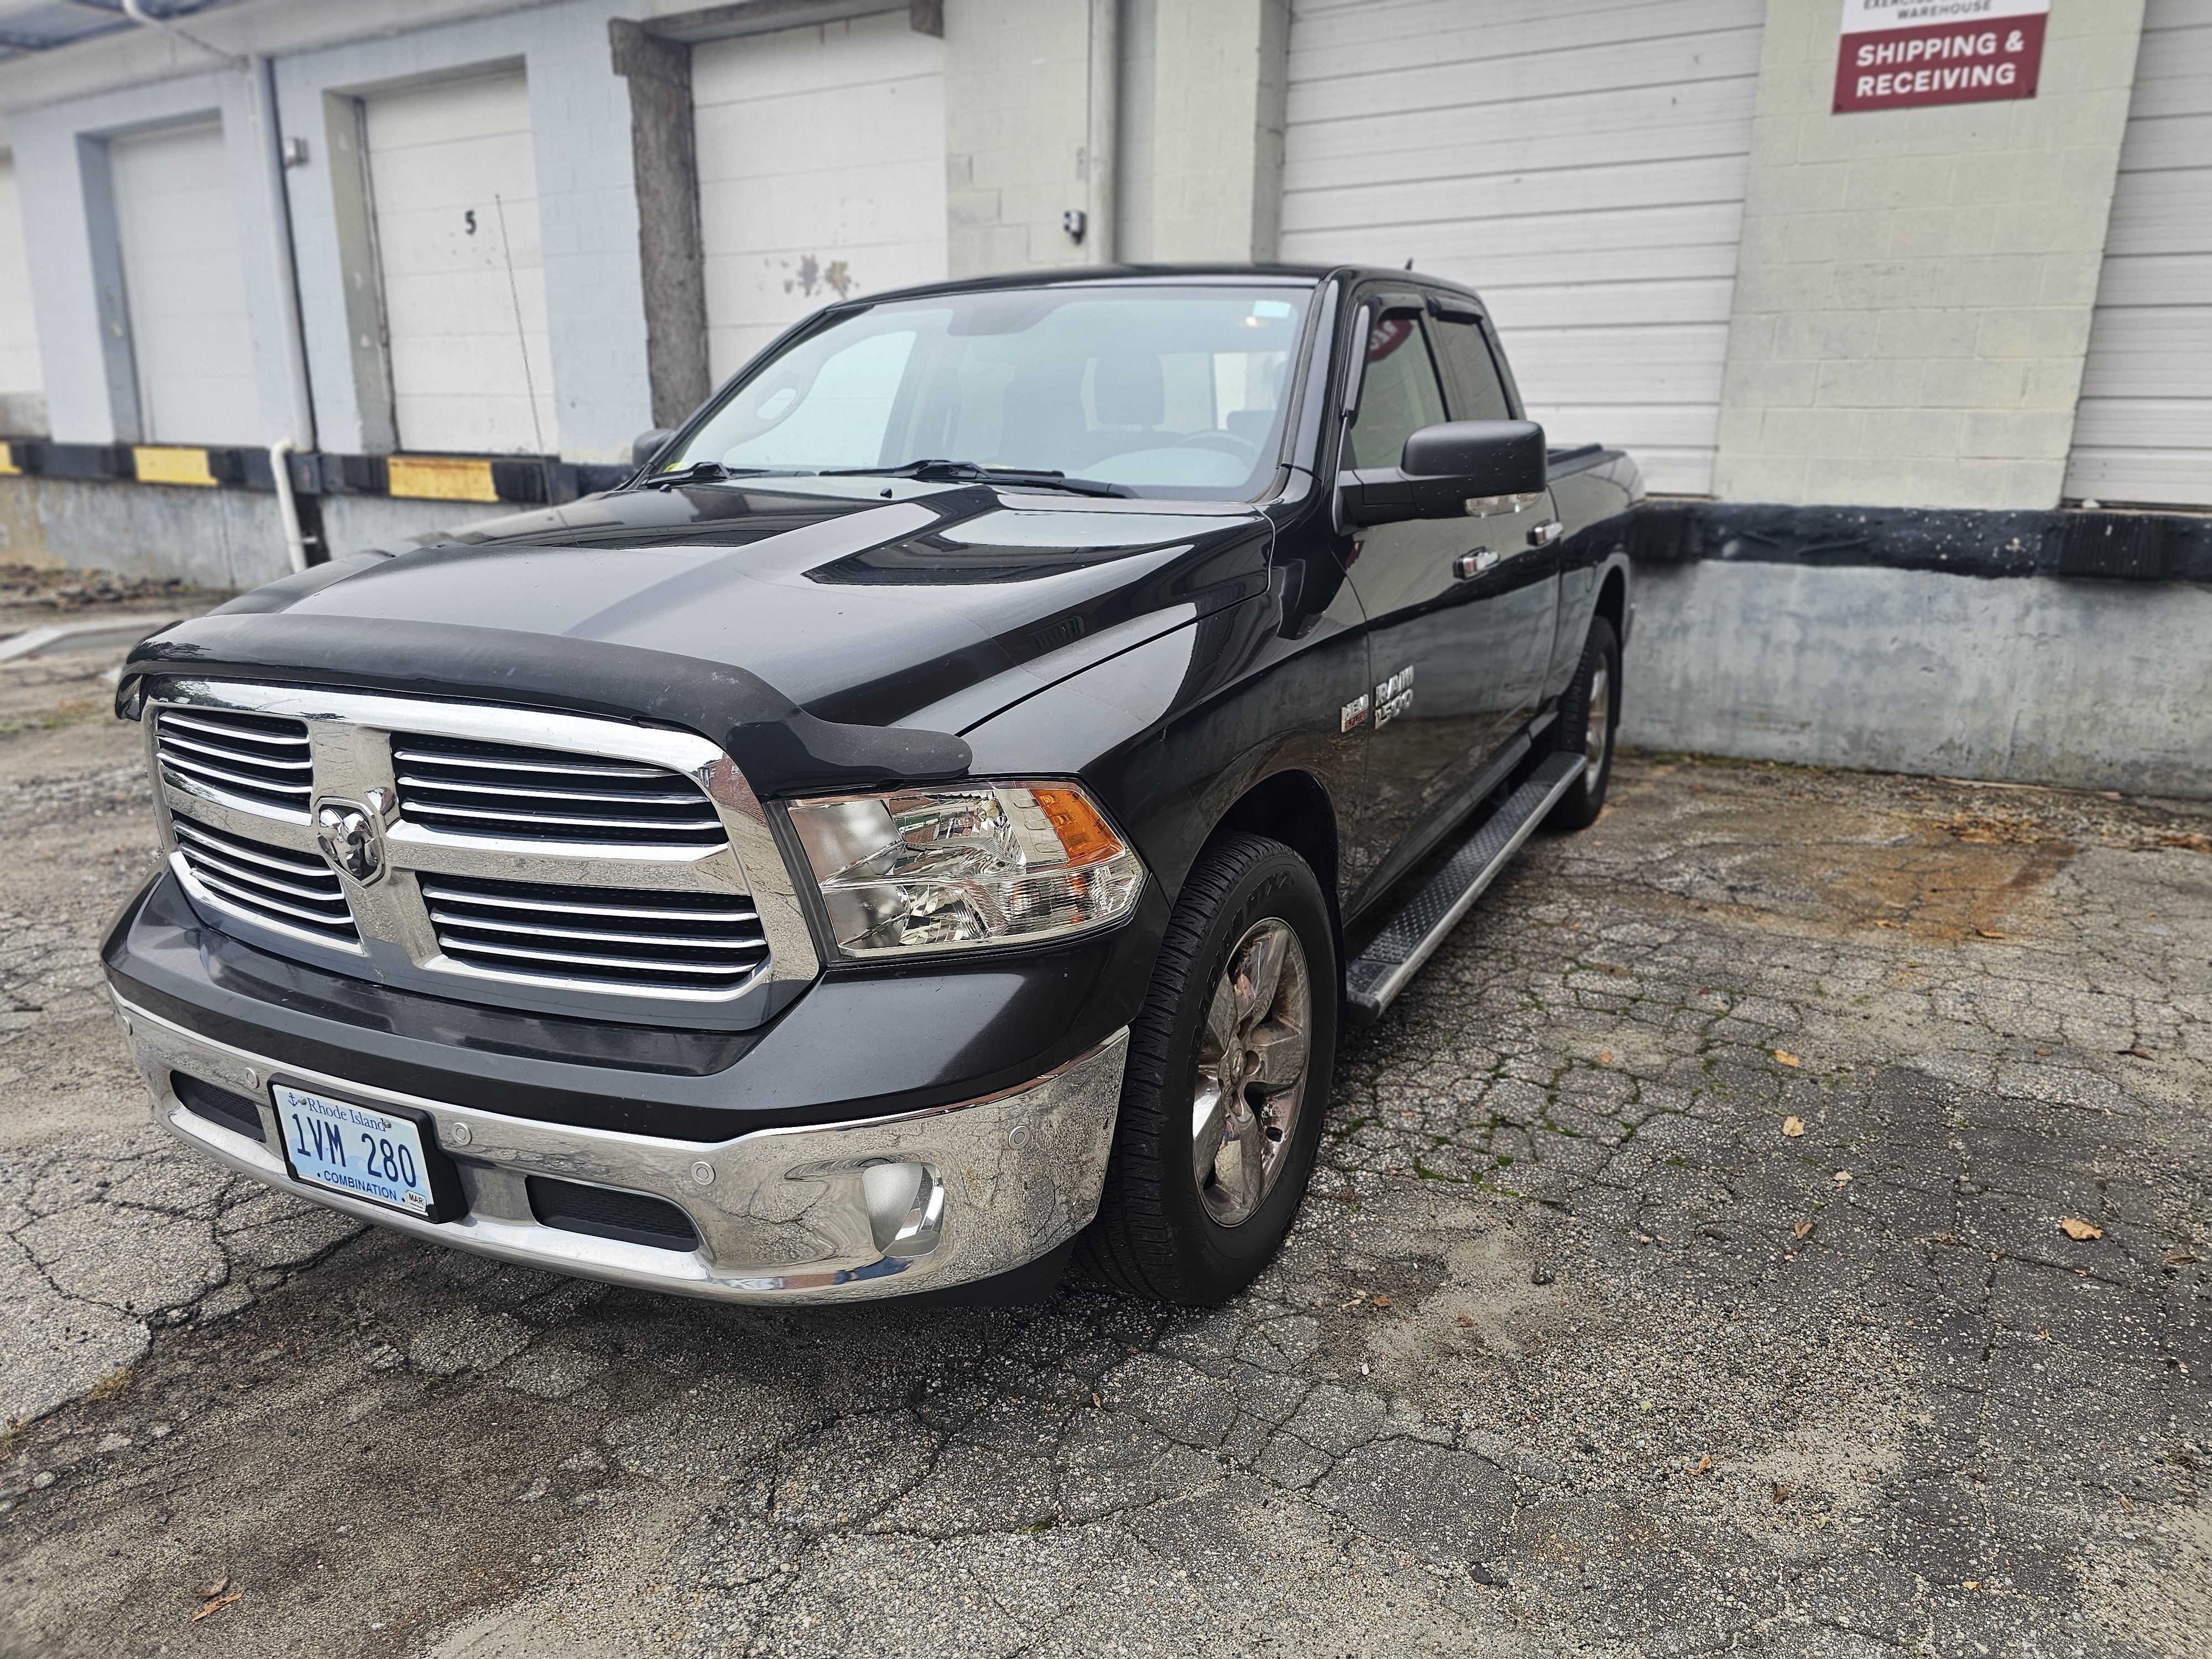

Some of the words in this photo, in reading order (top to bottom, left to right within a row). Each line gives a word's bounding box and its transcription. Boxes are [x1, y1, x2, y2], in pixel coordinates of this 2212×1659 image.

[1897, 1, 1991, 19] WAREHOUSE
[1856, 33, 1997, 66] SHIPPING
[2005, 30, 2024, 52] &
[1856, 63, 2016, 97] RECEIVING
[465, 210, 476, 235] 5
[1375, 665, 1414, 708] RAM
[1375, 688, 1413, 729] 1500
[306, 1097, 348, 1121] Rhode
[348, 1109, 387, 1132] Island
[292, 1113, 347, 1168] 1VM
[361, 1133, 416, 1188] 280
[324, 1170, 397, 1201] COMBINATION
[409, 1193, 424, 1206] MAR
